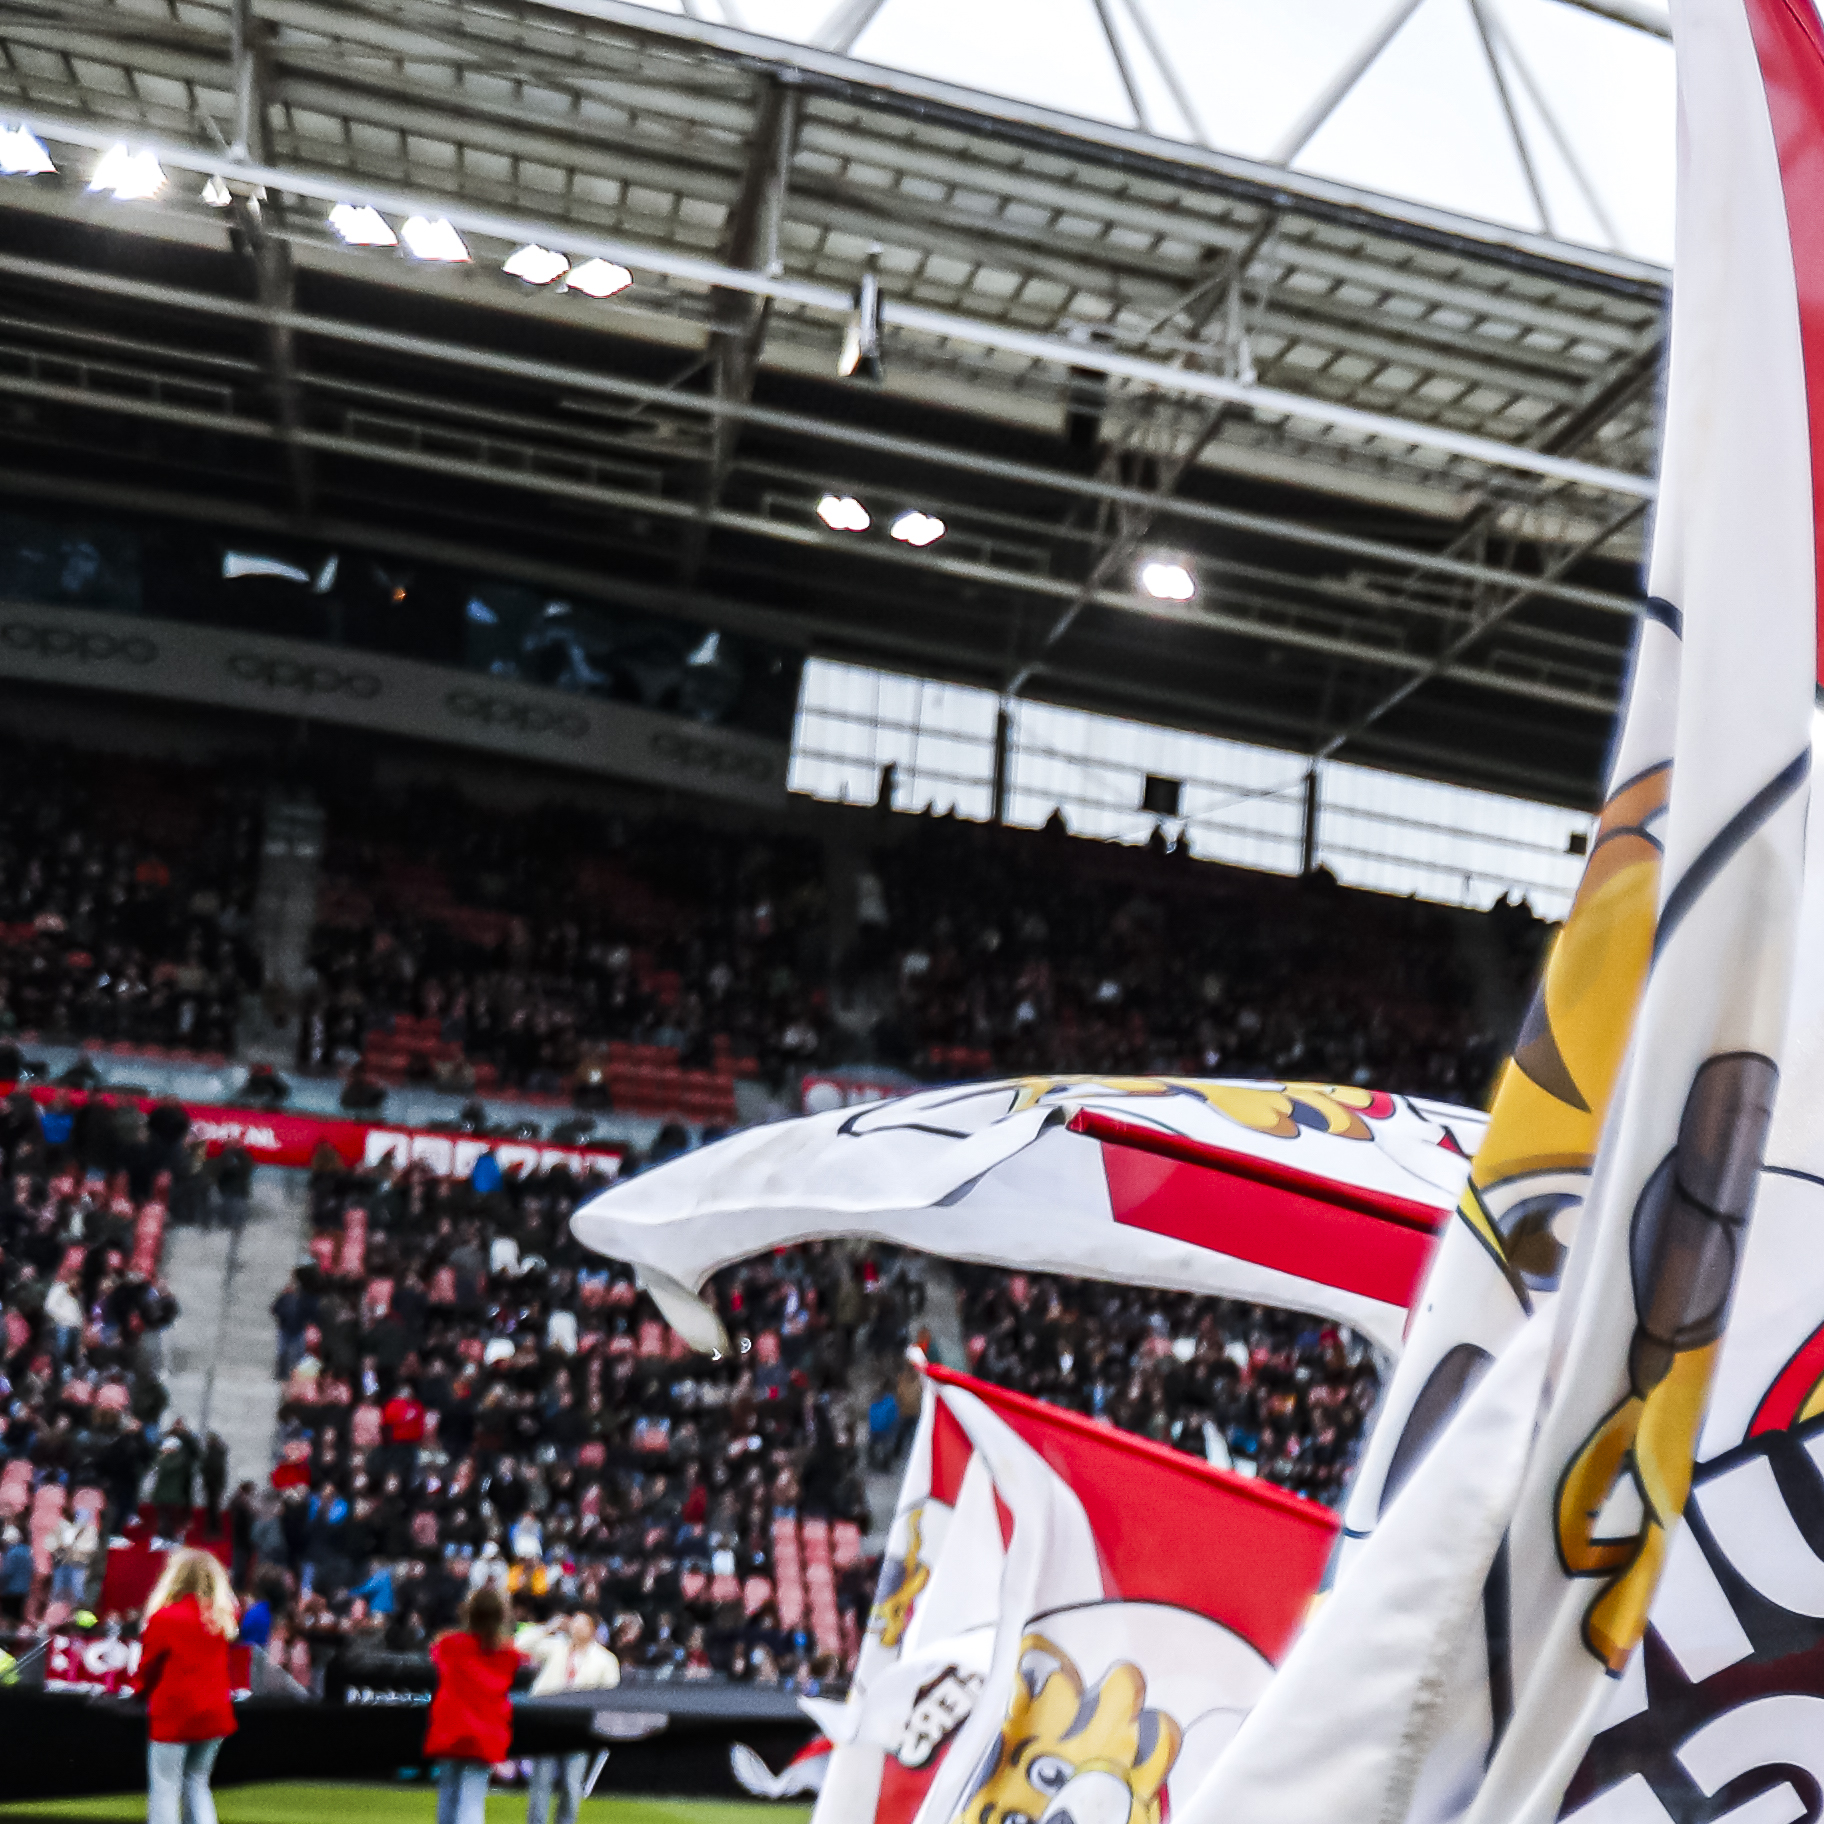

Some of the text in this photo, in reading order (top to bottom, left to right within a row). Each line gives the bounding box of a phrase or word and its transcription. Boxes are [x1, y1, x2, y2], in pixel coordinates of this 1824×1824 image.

[1, 621, 159, 664] oppo
[227, 651, 382, 699] oppo
[446, 687, 591, 740] oppo
